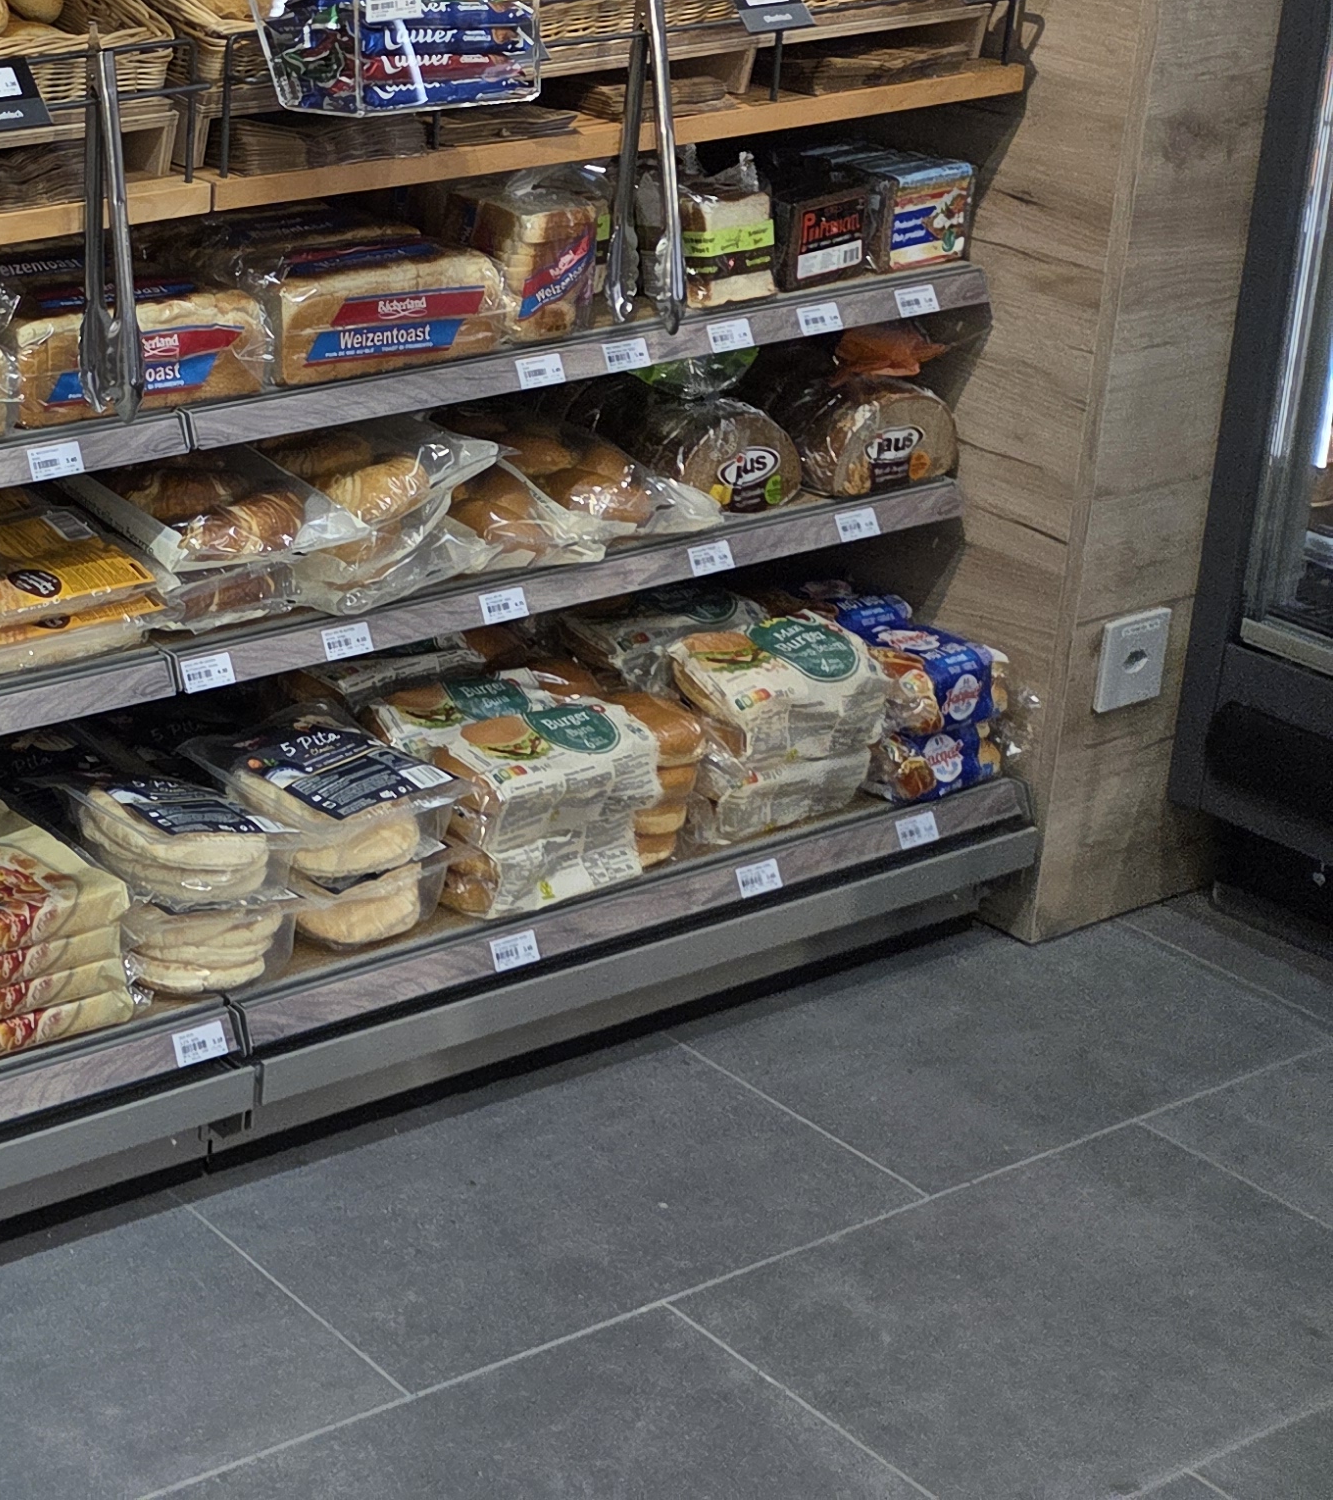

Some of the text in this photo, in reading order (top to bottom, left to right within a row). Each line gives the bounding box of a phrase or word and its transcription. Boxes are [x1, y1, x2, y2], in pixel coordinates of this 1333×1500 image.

[340, 324, 431, 349] Weizentoast
[541, 712, 591, 729] Burger
[280, 731, 340, 756] 5 Pita
